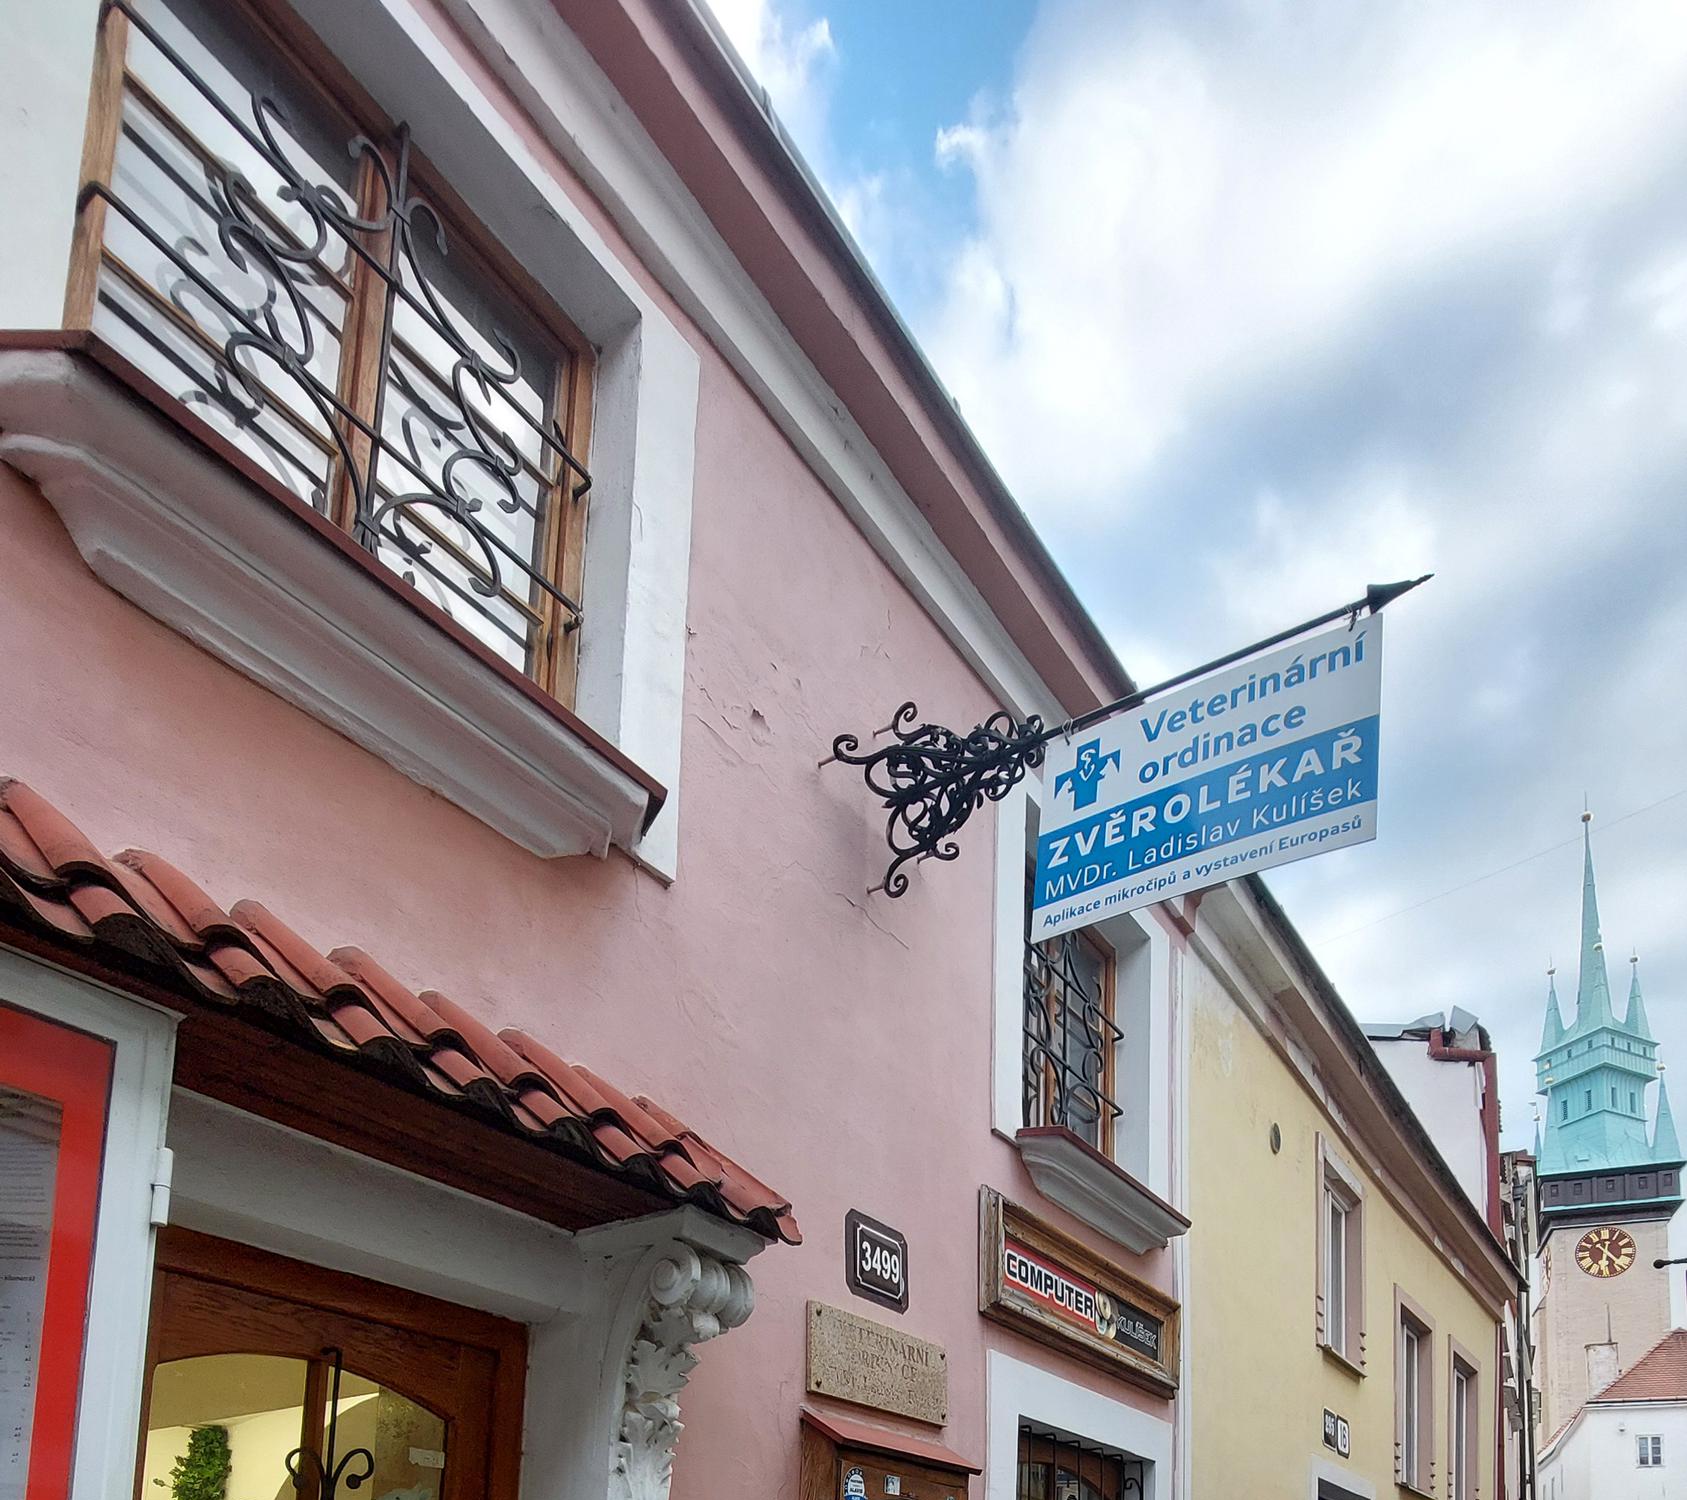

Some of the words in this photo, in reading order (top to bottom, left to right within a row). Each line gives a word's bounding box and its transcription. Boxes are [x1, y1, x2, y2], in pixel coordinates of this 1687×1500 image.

[1140, 630, 1367, 744] Veterinární
[1138, 705, 1306, 785] ordinace
[1045, 860, 1117, 901] MVDr.
[1128, 815, 1241, 871] Ladislav
[1252, 777, 1362, 828] Kulíšek
[1047, 727, 1363, 869] ZVĚROLÉKAŘ
[1043, 898, 1101, 928] Aplikace
[1105, 870, 1177, 909] mikročipů
[1182, 868, 1192, 880] a
[1195, 840, 1274, 881] vystavení
[1278, 815, 1362, 852] Europasů
[861, 1240, 901, 1284] 3499
[1004, 1248, 1096, 1321] COMPUTER
[1340, 1423, 1348, 1449] 16
